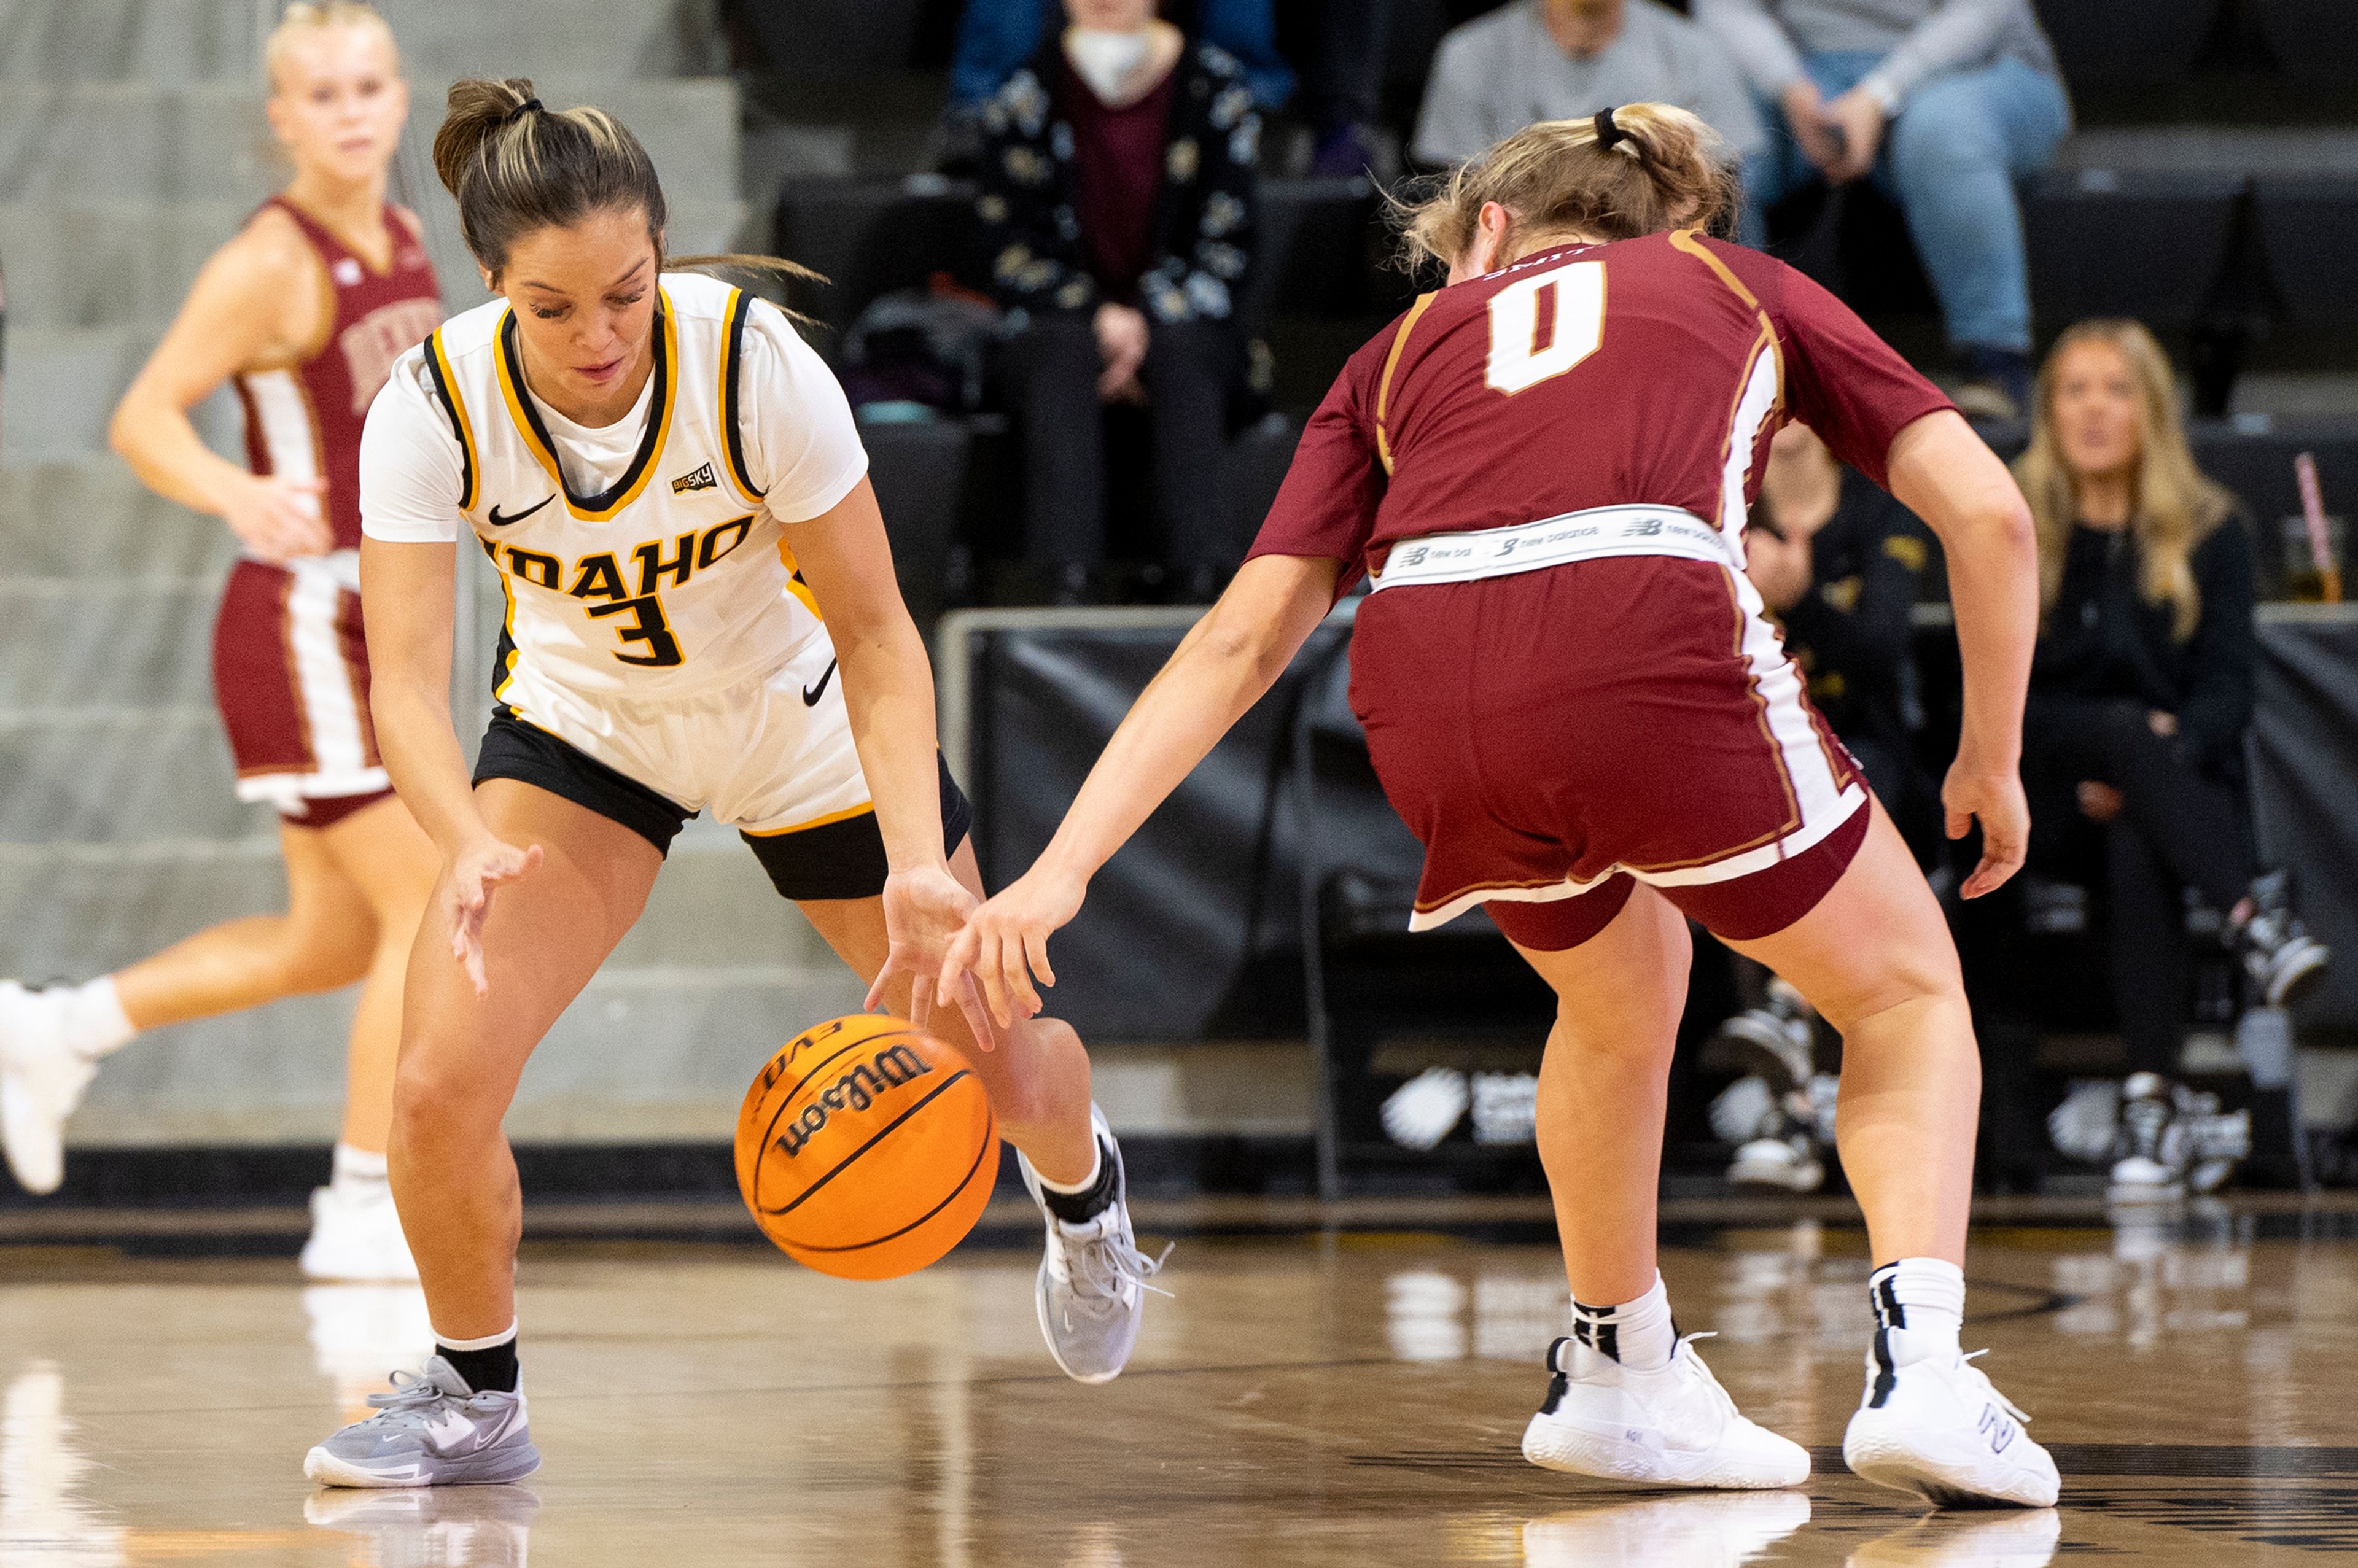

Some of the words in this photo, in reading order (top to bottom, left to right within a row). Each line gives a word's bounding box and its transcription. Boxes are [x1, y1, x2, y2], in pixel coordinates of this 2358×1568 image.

[1482, 242, 1610, 282] SMIT
[1484, 260, 1608, 397] 0
[1546, 526, 1600, 543] balance
[583, 593, 686, 668] 3
[775, 1044, 935, 1157] Wilson
